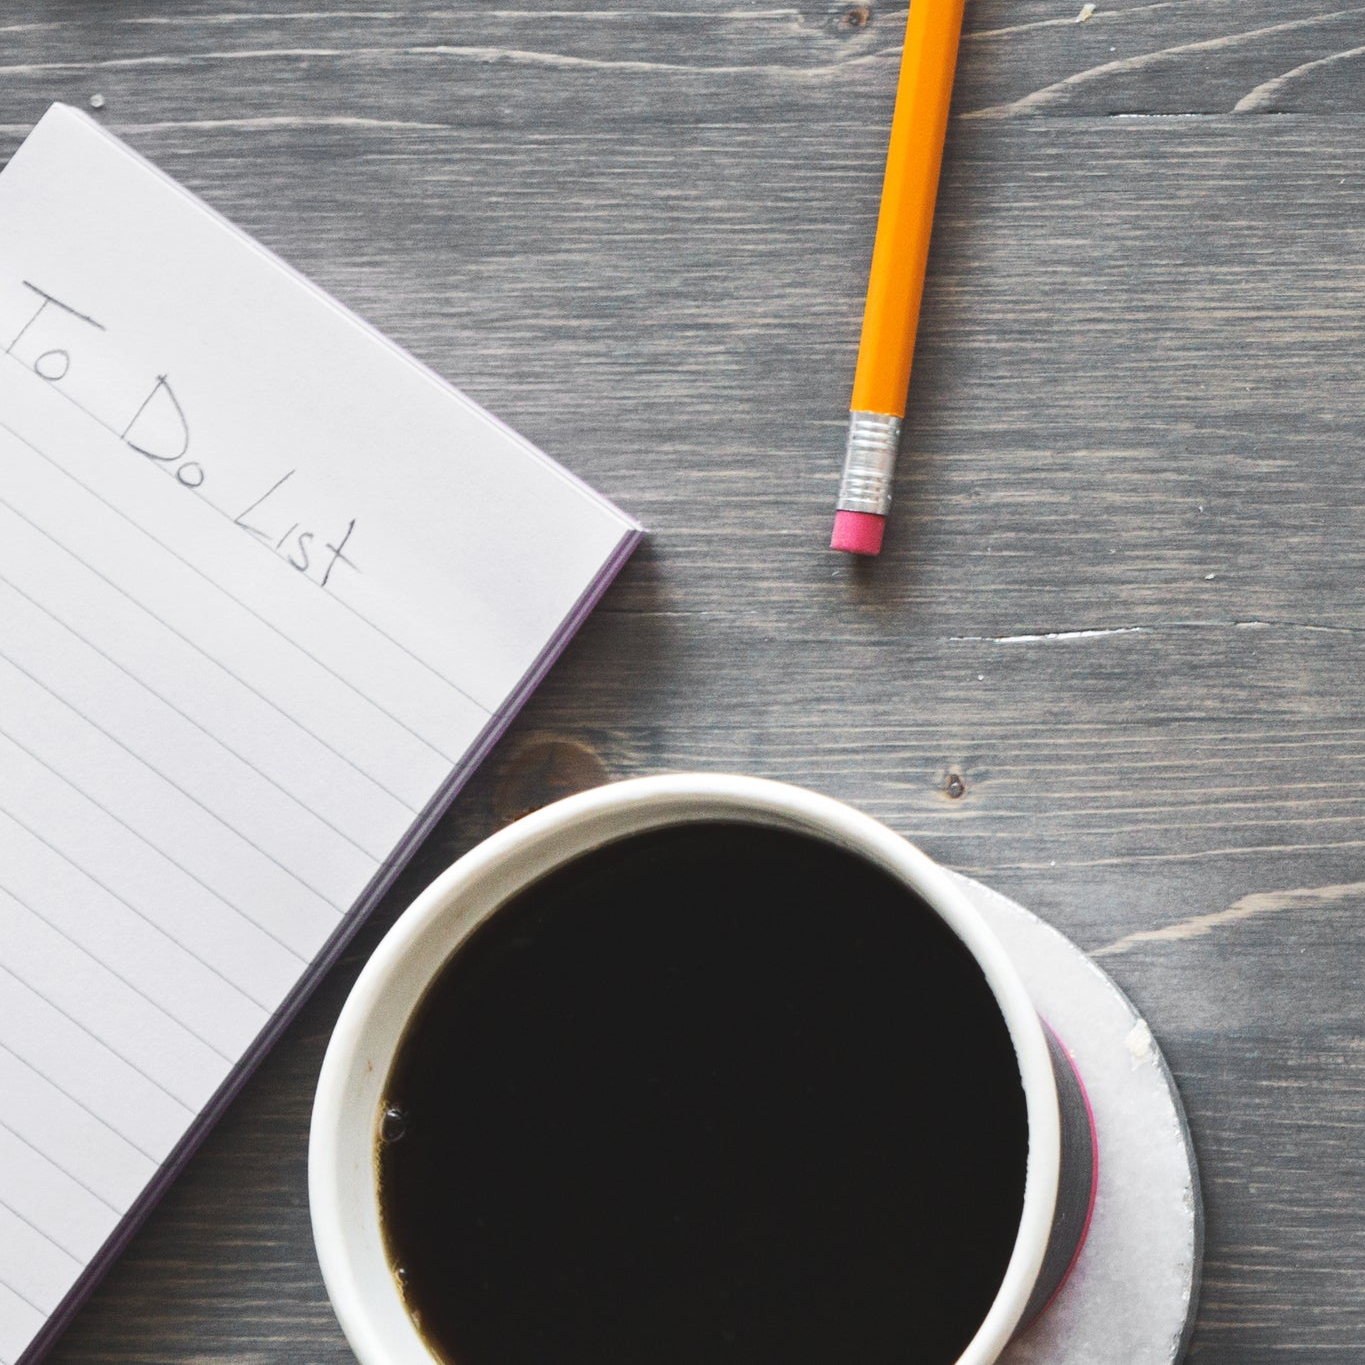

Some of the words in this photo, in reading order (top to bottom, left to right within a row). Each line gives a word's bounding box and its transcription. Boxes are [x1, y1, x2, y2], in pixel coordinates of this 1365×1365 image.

[5, 280, 107, 381] To
[120, 373, 205, 488] Do
[234, 469, 362, 587] List
